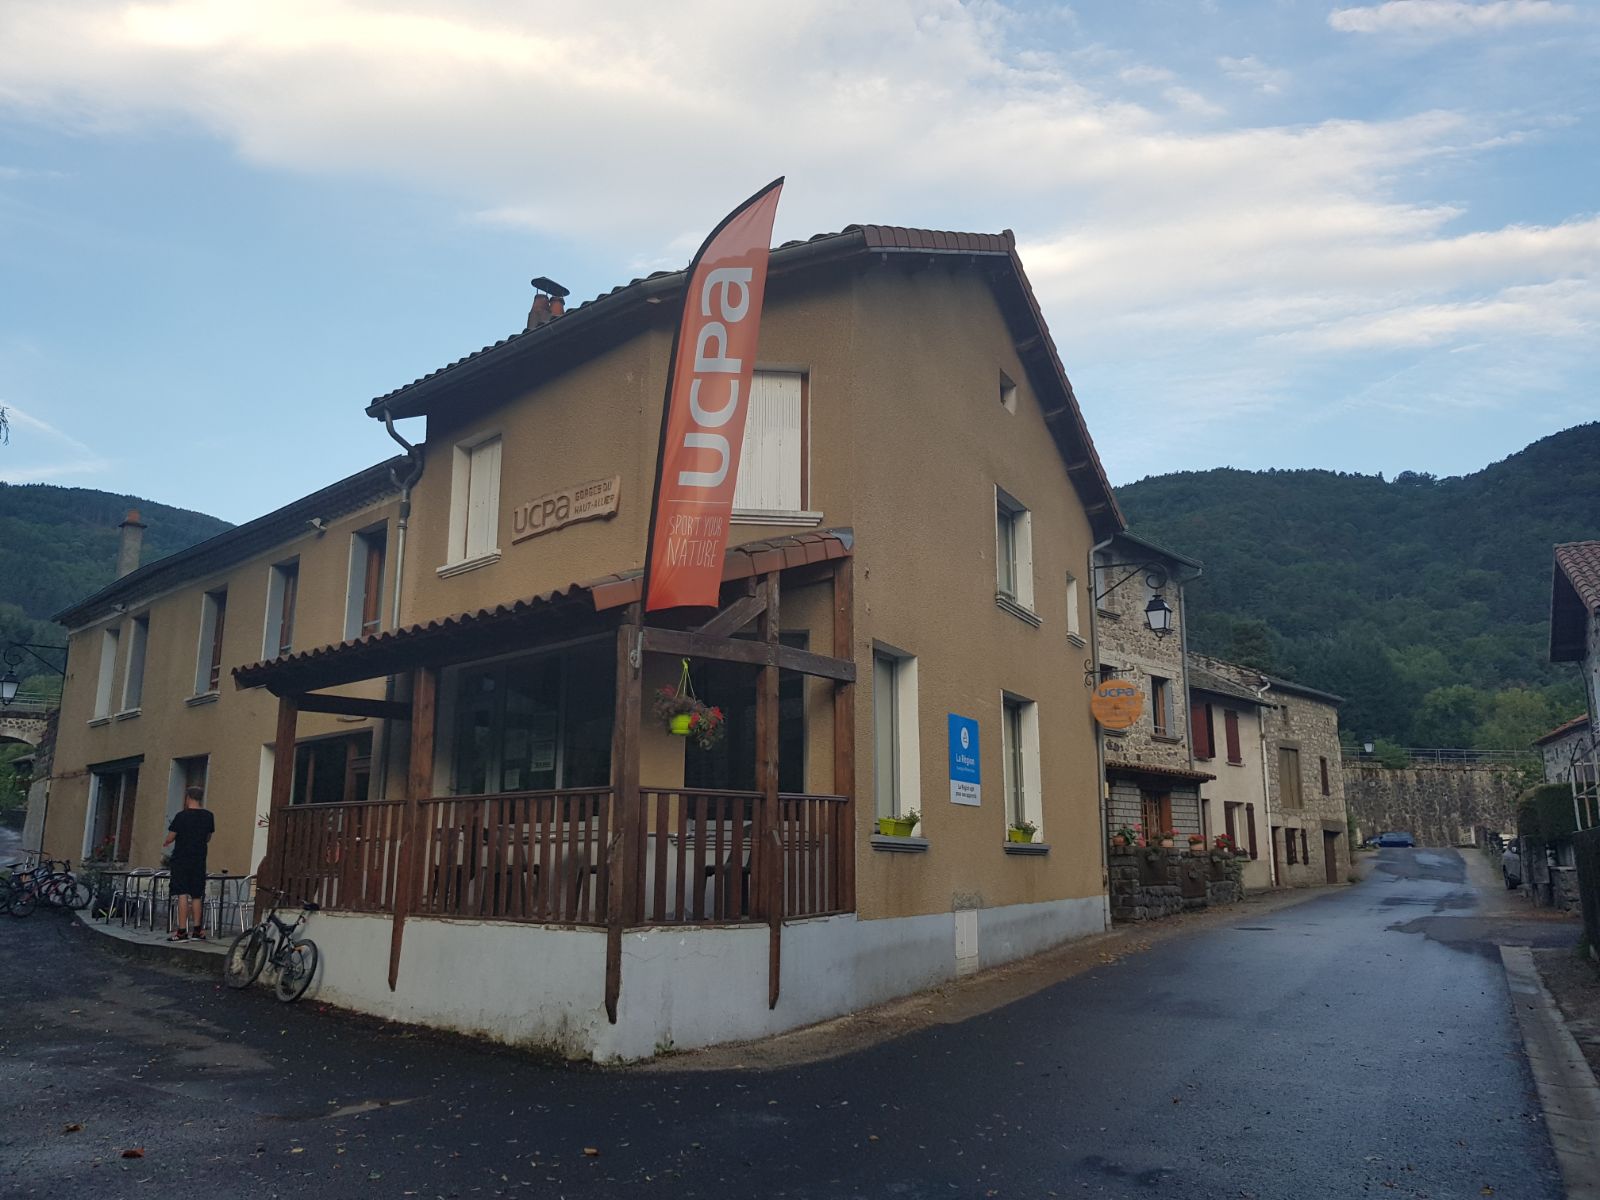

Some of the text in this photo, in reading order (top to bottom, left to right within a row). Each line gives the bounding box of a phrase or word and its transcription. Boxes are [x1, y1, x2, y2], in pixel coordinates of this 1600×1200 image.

[575, 480, 613, 501] GORGES DU
[574, 494, 615, 515] HAUT-ALLIER
[669, 514, 723, 537] SPORT YOUR
[666, 537, 720, 568] NATURE
